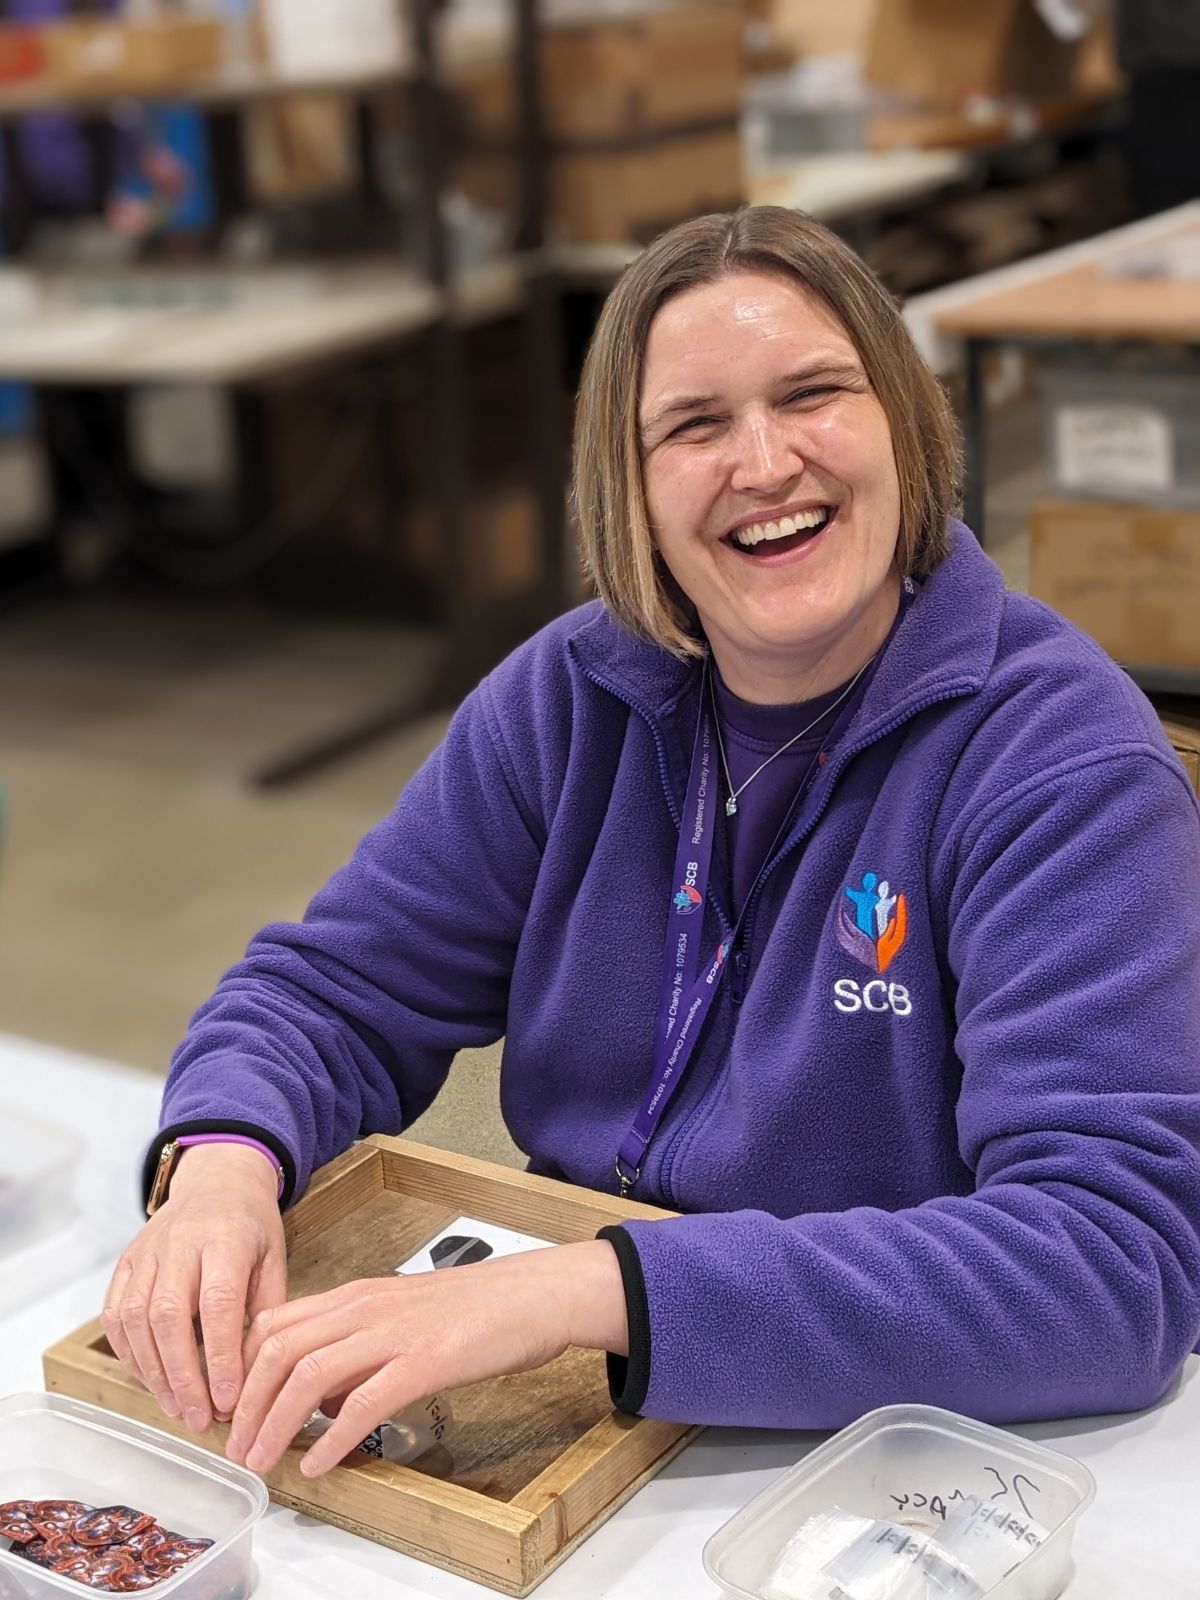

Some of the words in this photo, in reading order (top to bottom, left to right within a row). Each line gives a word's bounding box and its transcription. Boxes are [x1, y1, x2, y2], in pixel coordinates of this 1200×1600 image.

[698, 767, 710, 797] Charity
[692, 798, 706, 845] Registered
[685, 861, 698, 887] SCB
[676, 933, 688, 967] 1079534
[674, 971, 683, 985] No:
[706, 961, 720, 984] SCB
[668, 986, 682, 1016] Charity
[833, 978, 912, 1016] SCB
[680, 997, 702, 1039] Registered
[667, 1039, 684, 1068] Charity
[647, 1083, 666, 1115] 1079534
